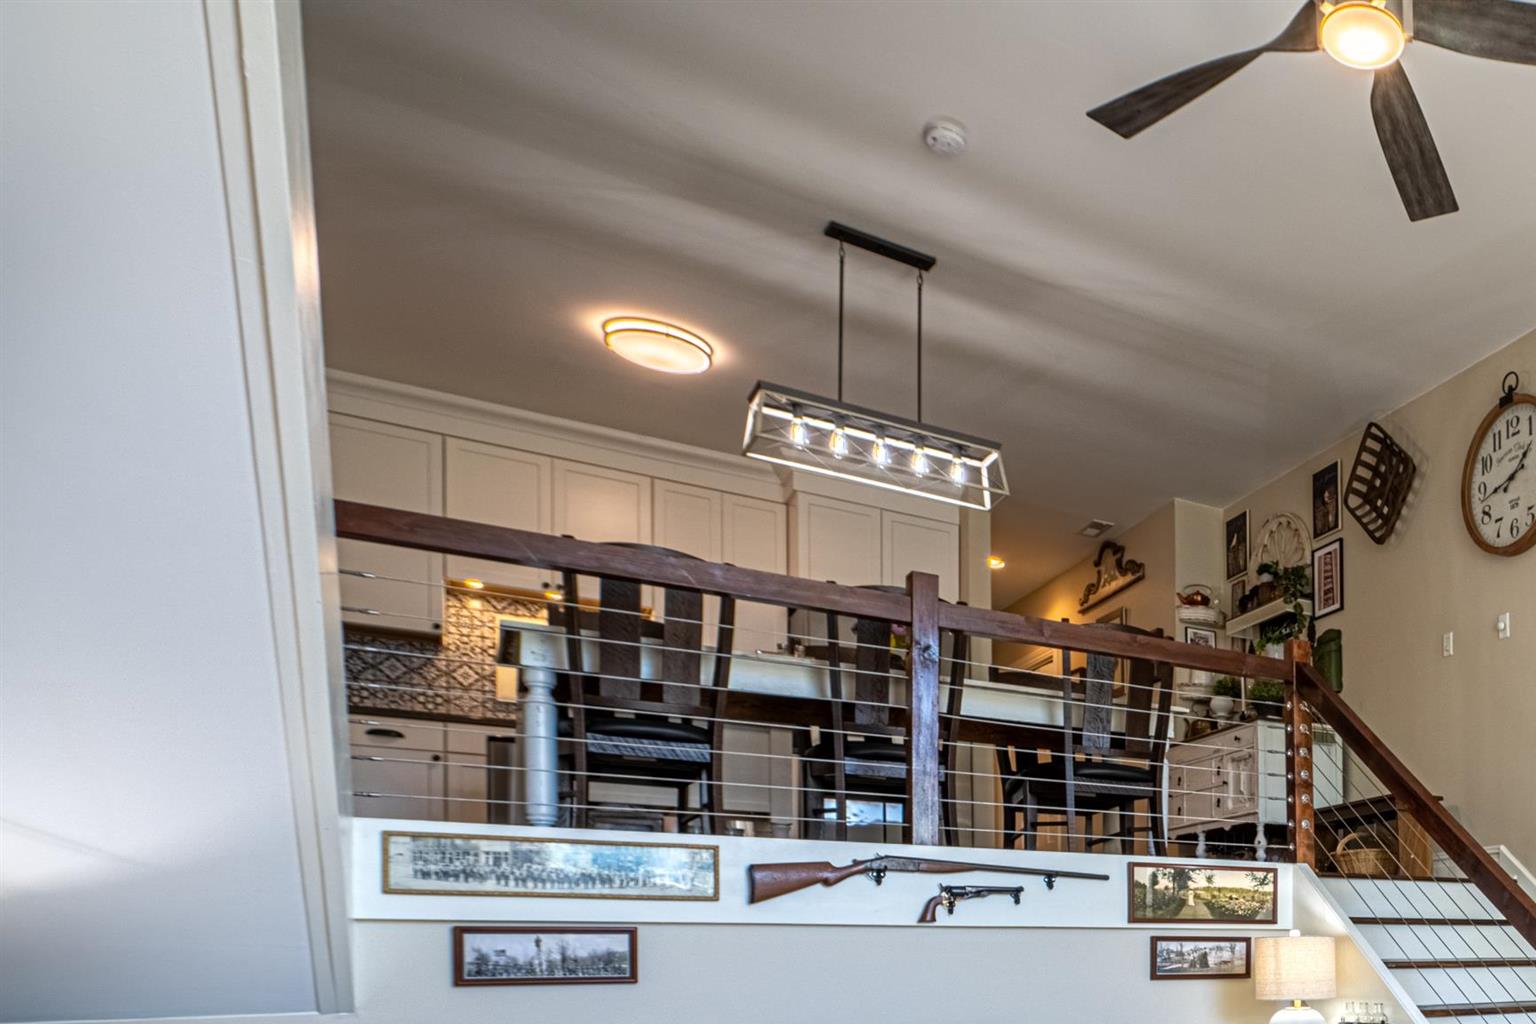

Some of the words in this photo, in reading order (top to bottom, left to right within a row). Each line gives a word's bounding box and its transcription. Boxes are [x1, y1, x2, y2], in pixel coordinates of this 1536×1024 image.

[1505, 415, 1520, 439] 12
[1527, 414, 1533, 436] 1
[1492, 429, 1502, 452] 11
[1481, 453, 1493, 476] 10
[1478, 481, 1488, 502] 9
[1480, 504, 1492, 526] 8
[1525, 505, 1536, 527] 5
[1494, 516, 1504, 539] 7
[1509, 518, 1520, 539] 6
